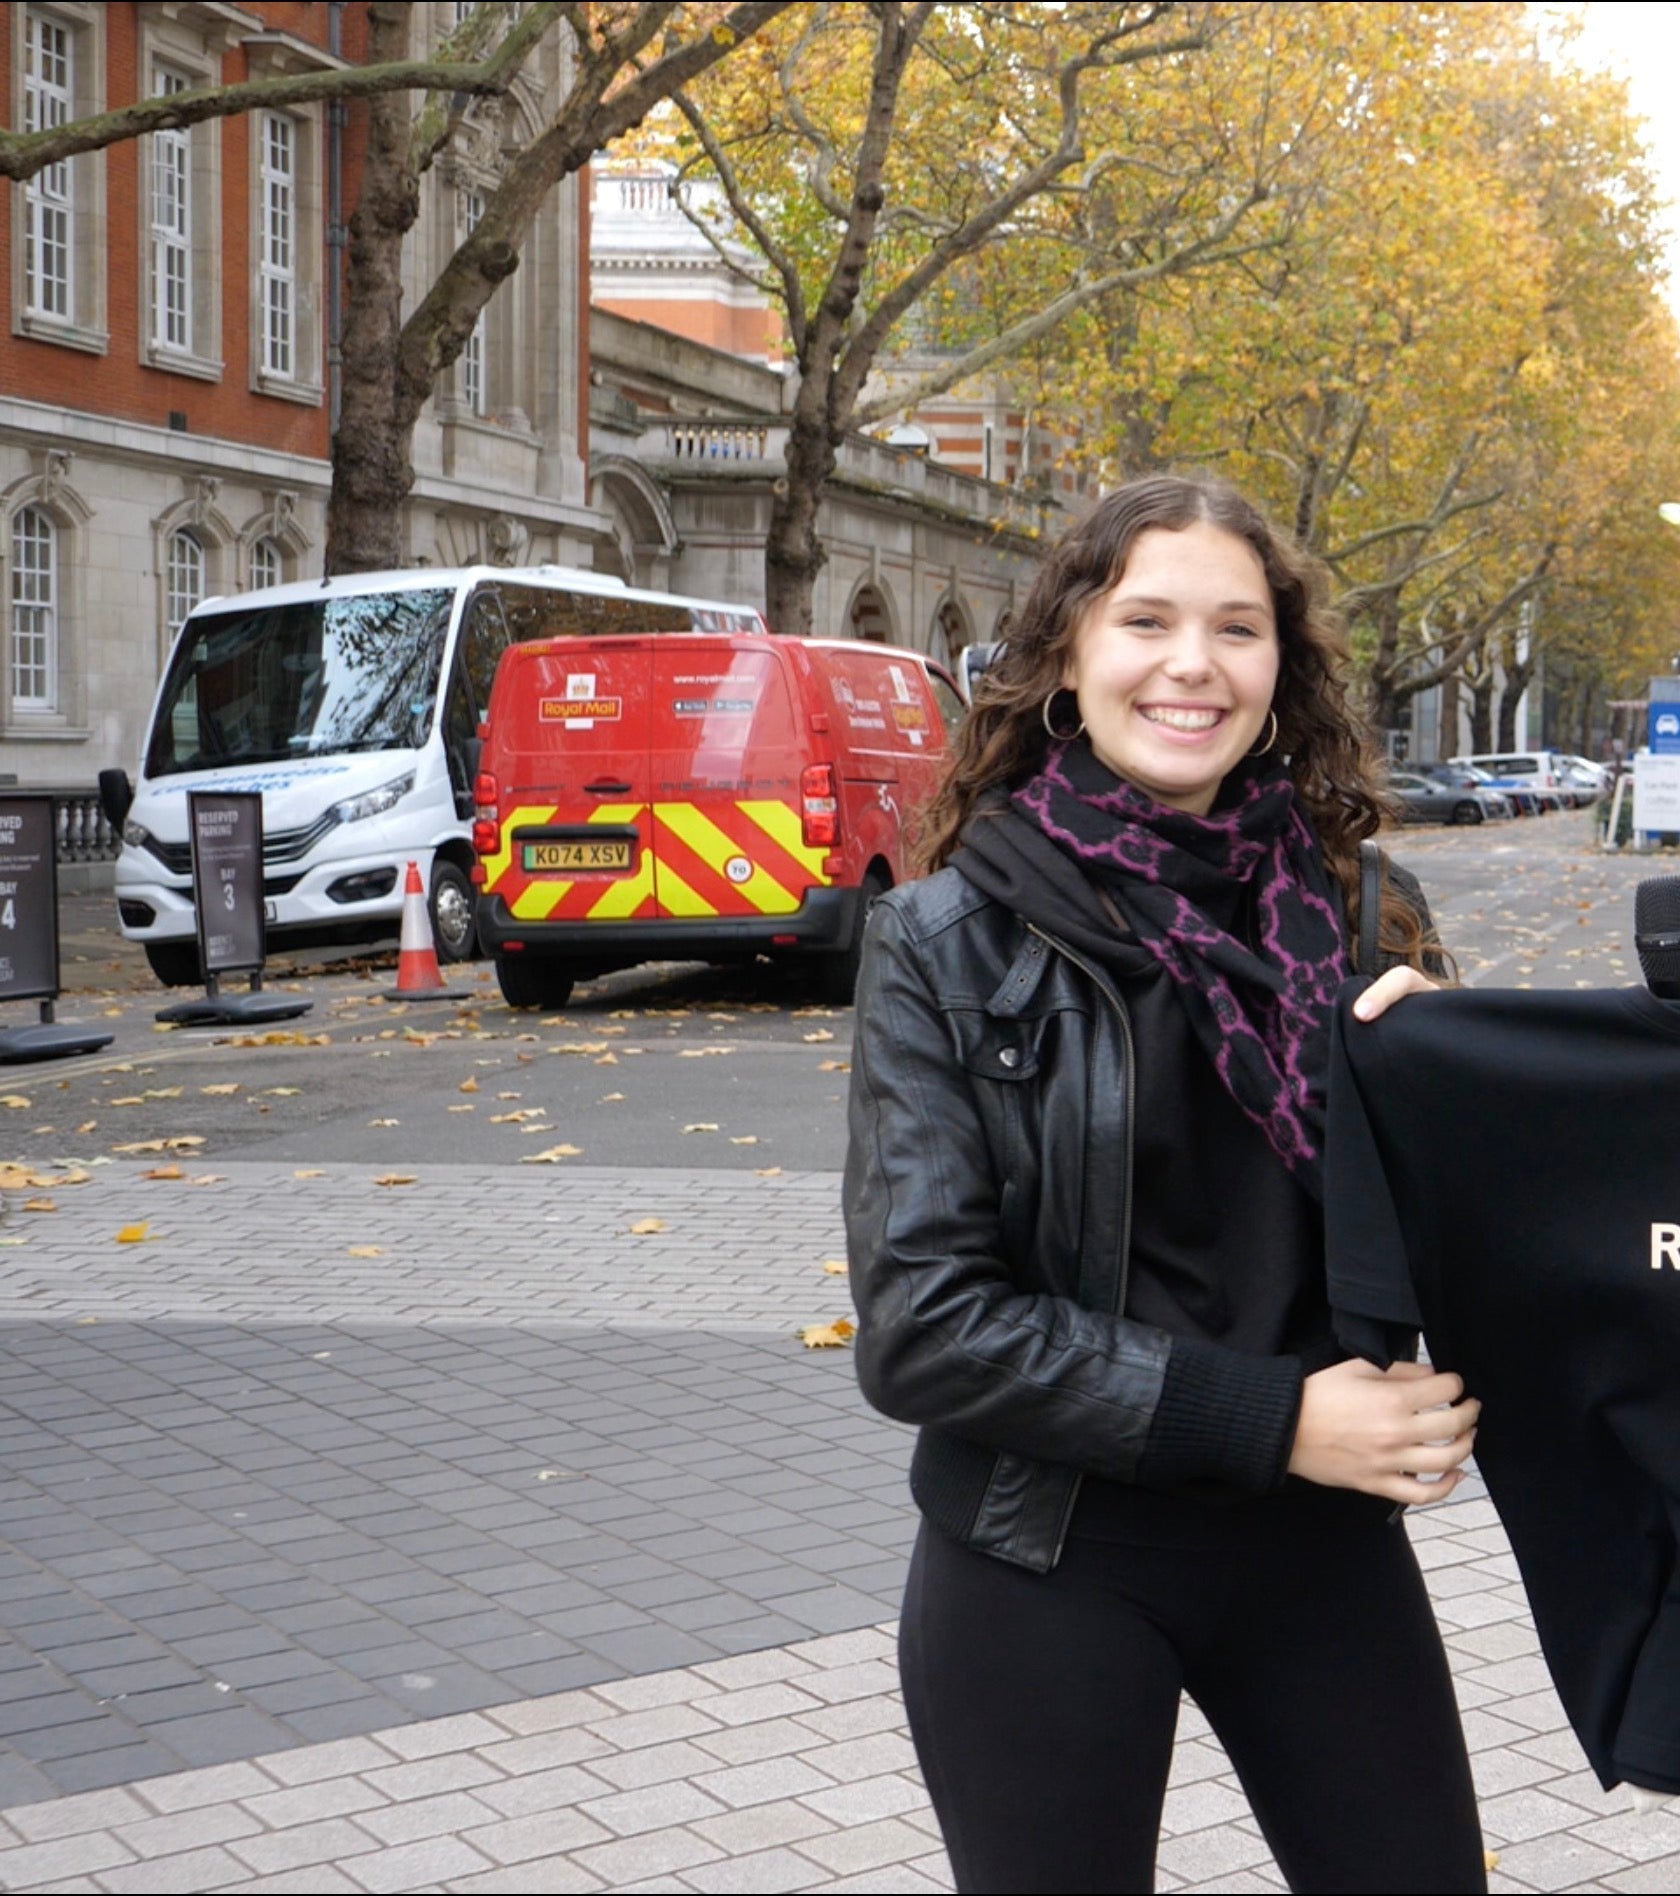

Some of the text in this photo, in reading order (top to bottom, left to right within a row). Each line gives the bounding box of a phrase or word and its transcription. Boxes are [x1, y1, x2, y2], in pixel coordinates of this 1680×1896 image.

[543, 701, 615, 717] Royal Mail
[590, 845, 627, 864] XSV
[224, 883, 235, 911] 3
[2, 898, 16, 930] 4
